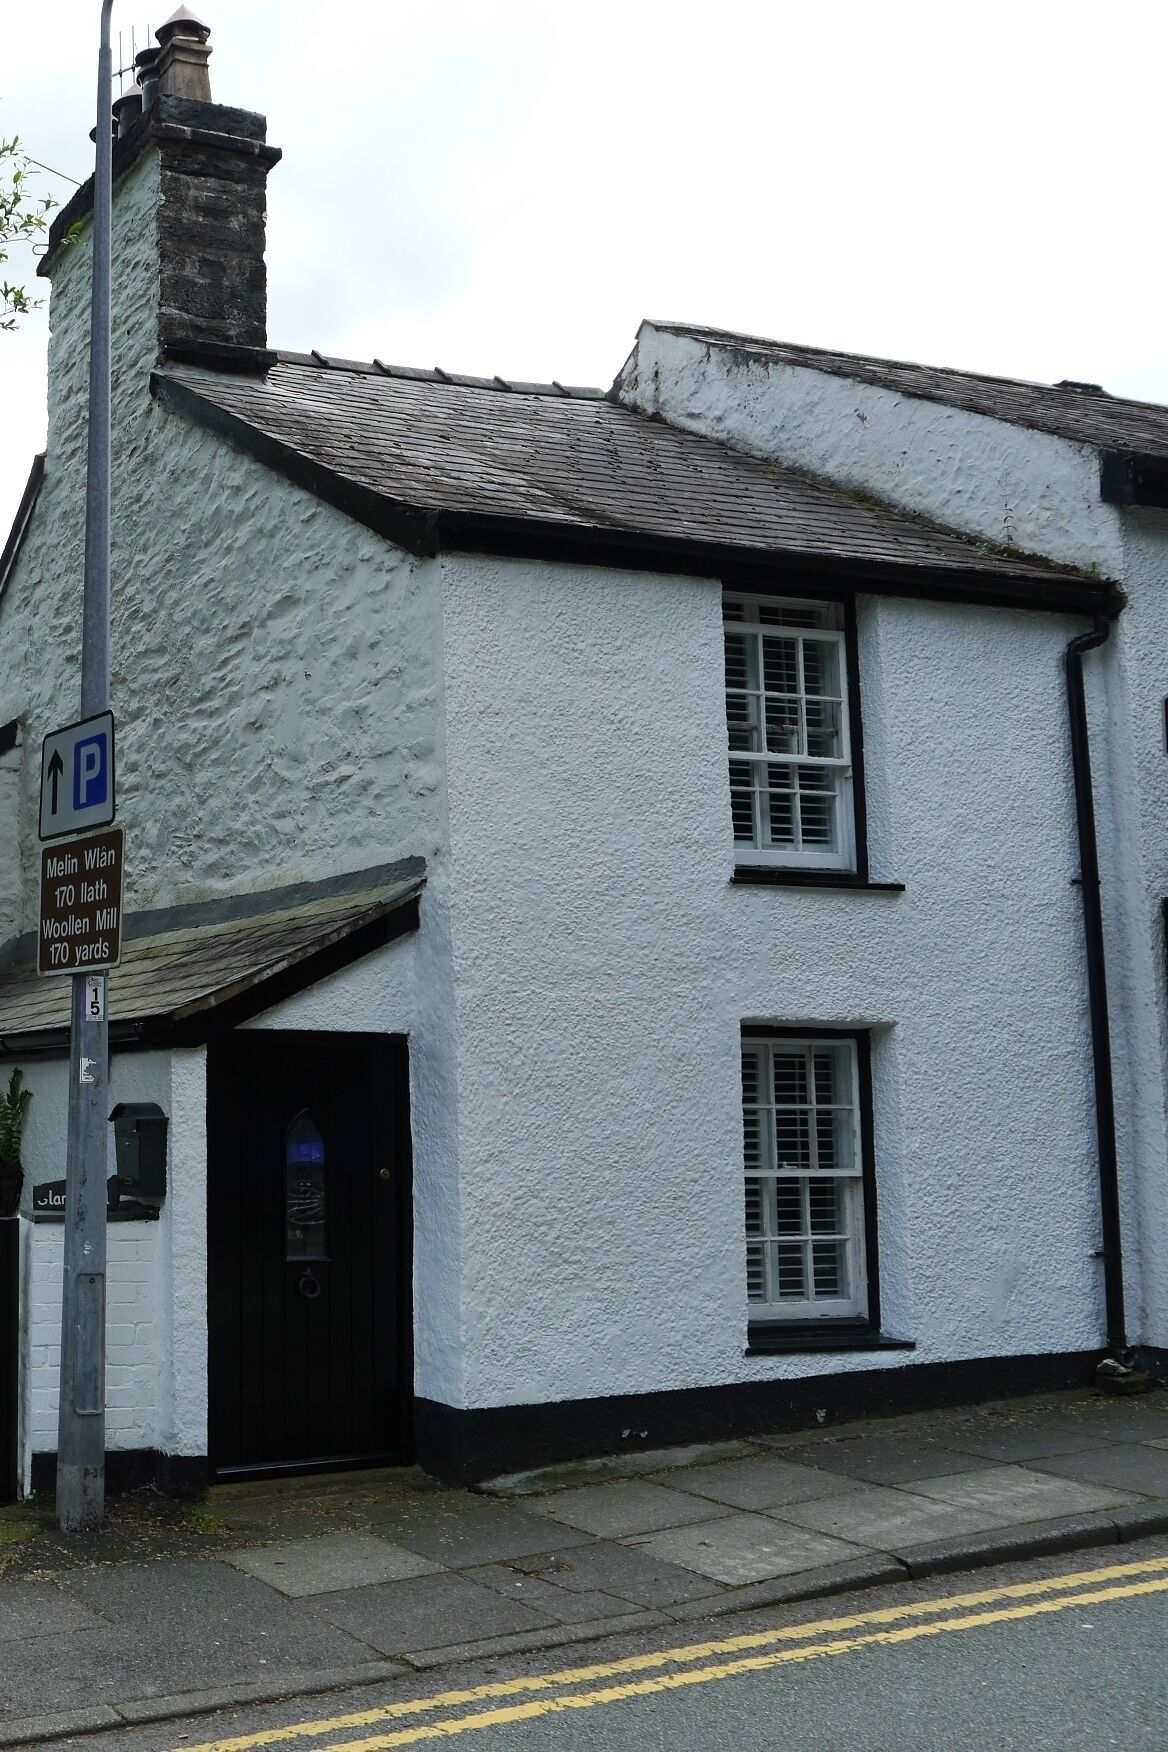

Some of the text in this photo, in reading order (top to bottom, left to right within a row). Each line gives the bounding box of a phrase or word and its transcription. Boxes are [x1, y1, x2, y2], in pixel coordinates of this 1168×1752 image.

[80, 742, 101, 804] P
[46, 846, 115, 879] Melin Wlân
[54, 879, 108, 908] 170 llath
[42, 907, 117, 939] Woollen Mill
[49, 937, 109, 966] 170 yards
